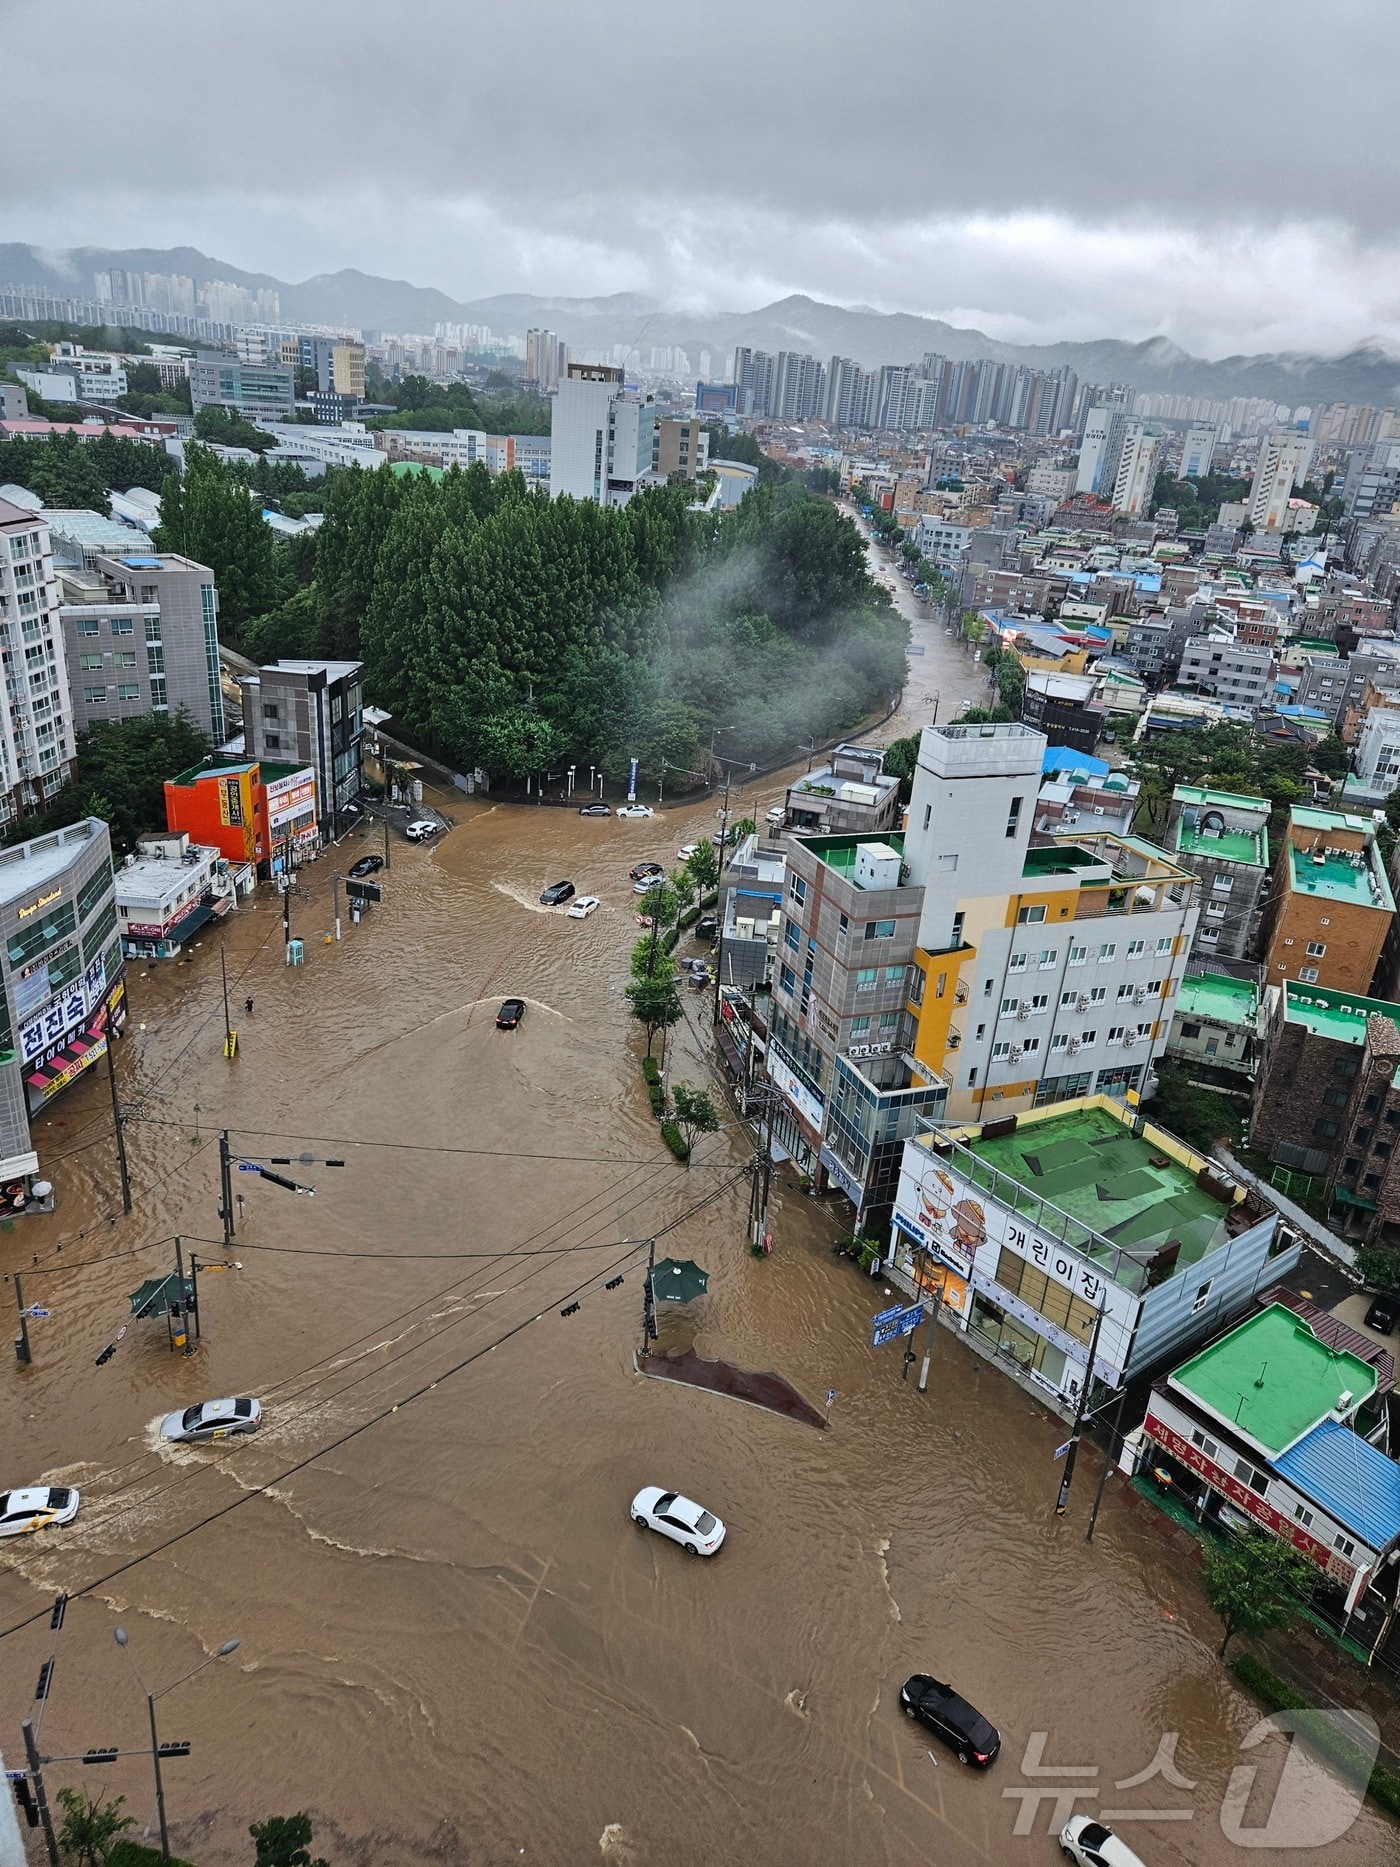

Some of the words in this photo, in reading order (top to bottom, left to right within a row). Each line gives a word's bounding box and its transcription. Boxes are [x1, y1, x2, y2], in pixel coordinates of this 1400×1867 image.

[53, 976, 86, 1008] 국회의원
[22, 995, 85, 1058] 전진숙
[35, 1022, 86, 1070] 타이어메카
[895, 1212, 925, 1240] PHILIPS
[1008, 1226, 1101, 1300] 개린이집
